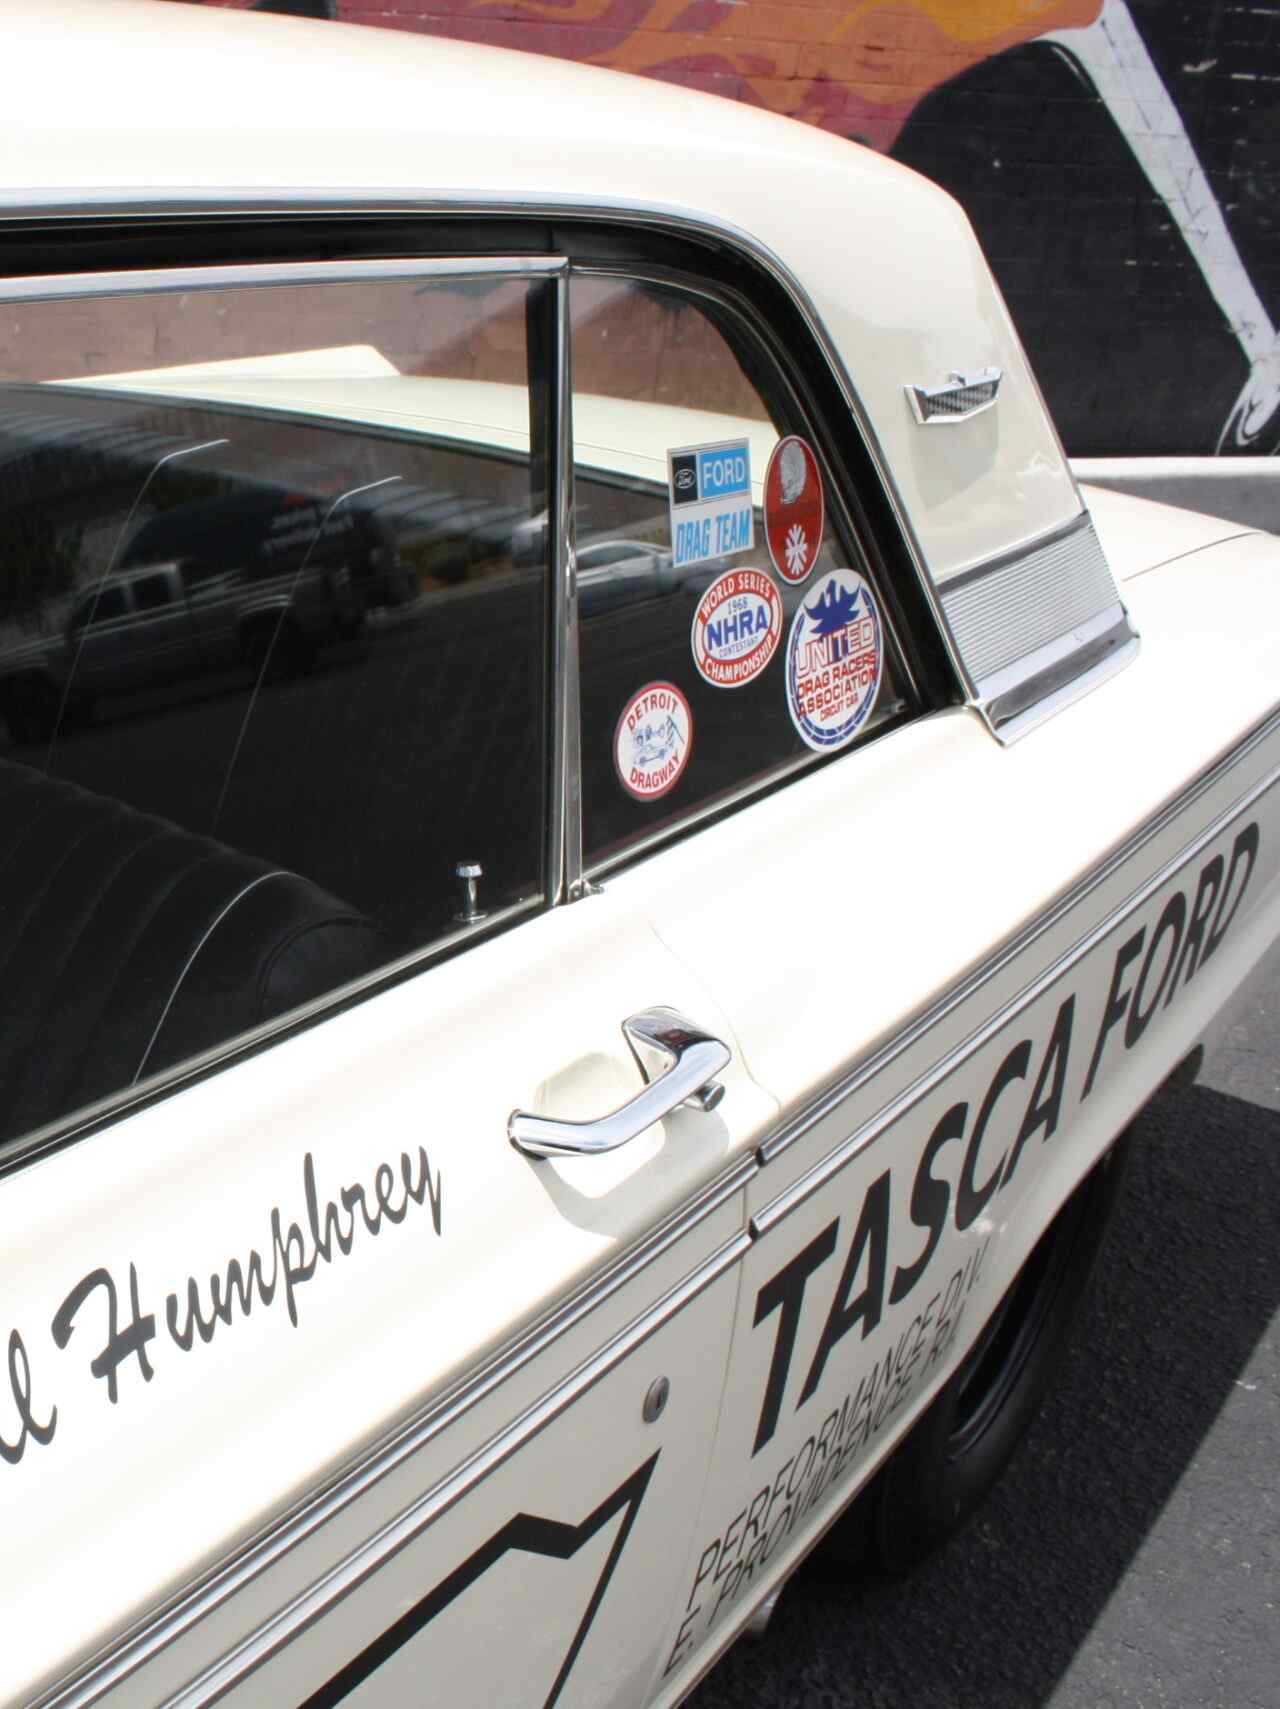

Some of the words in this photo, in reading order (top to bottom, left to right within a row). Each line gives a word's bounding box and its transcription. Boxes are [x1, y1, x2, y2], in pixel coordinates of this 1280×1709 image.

[702, 457, 746, 489] FORD
[676, 517, 712, 563] DRAG
[716, 509, 751, 554] TEAM
[701, 577, 735, 618] WORLD
[738, 573, 771, 598] SERIES
[707, 605, 769, 651] NHRA
[795, 615, 876, 680] UNITED
[705, 634, 774, 681] CHAMPIONSHIP
[797, 671, 830, 699] DRAG
[832, 650, 880, 680] RACERS
[627, 693, 678, 732] DETROIT
[797, 668, 879, 719] ASSOCIATION
[630, 748, 680, 788] DRAGWAY
[751, 993, 1076, 1459] TASCA
[1080, 821, 1260, 1104] FORD
[51, 1145, 442, 1404] Humphrey
[686, 1291, 941, 1612] PERFORMANCE
